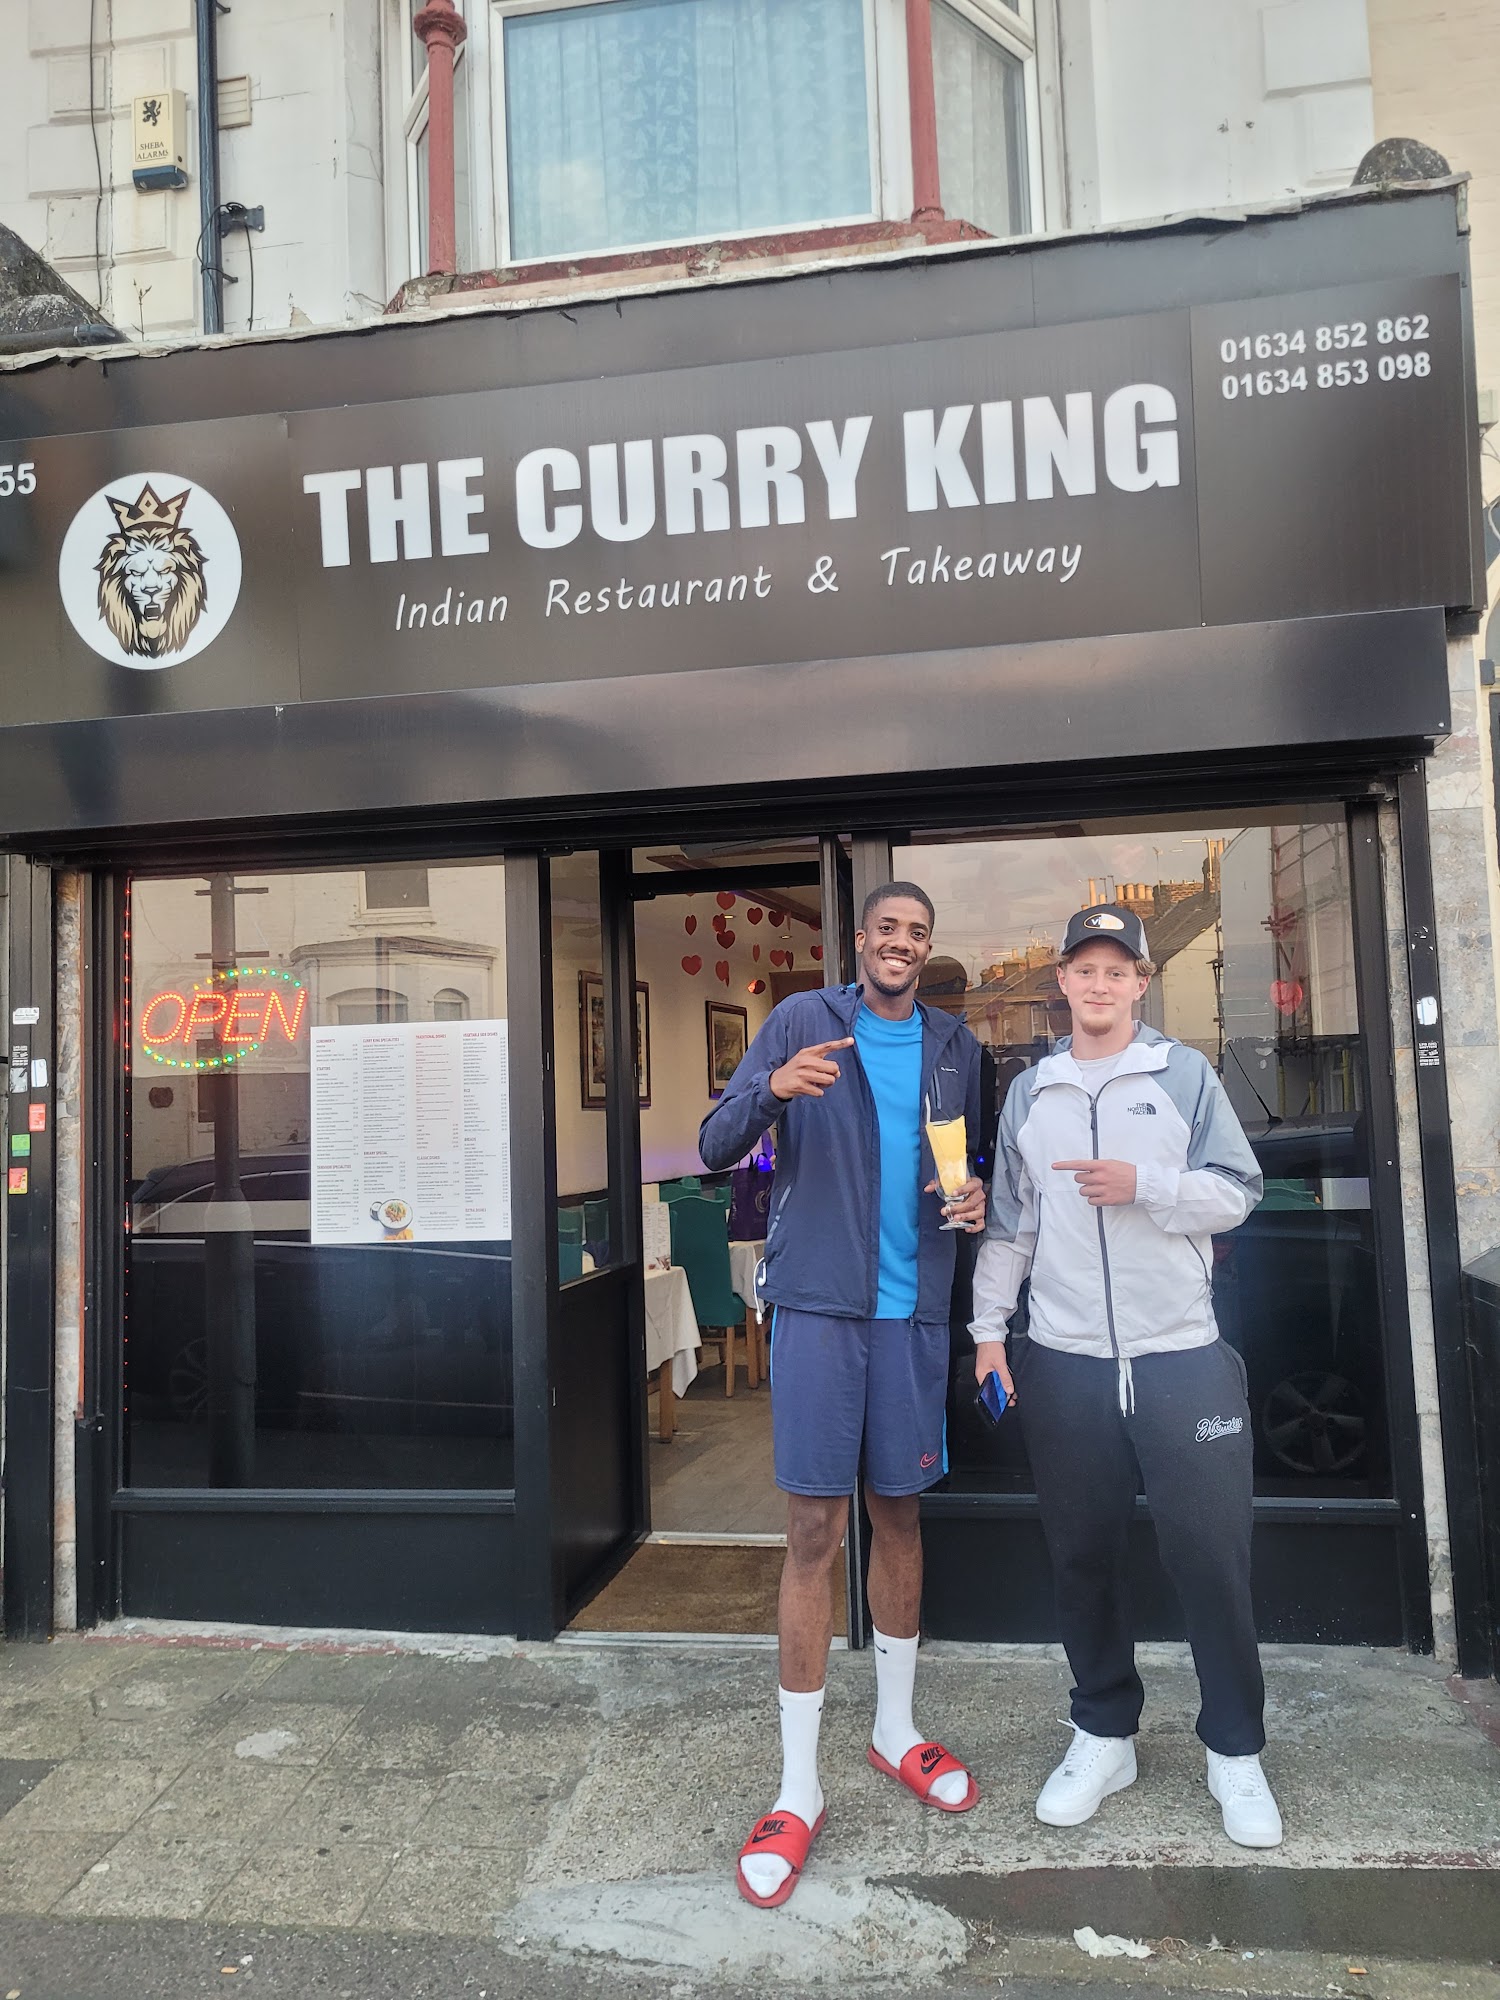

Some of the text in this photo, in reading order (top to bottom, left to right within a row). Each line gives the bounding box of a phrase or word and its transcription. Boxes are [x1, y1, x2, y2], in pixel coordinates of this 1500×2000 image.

[137, 149, 169, 160] ALARMS
[140, 141, 164, 150] SHEBA
[1220, 315, 1430, 364] 01634 852 862
[1221, 351, 1431, 400] 01634 853 098
[303, 383, 1180, 568] THE CURRY KING
[395, 544, 1082, 631] Indian Restaurant & Takeaway
[141, 989, 308, 1045] OPEN
[919, 1746, 942, 1764] NIKE
[759, 1819, 789, 1833] NIKE
